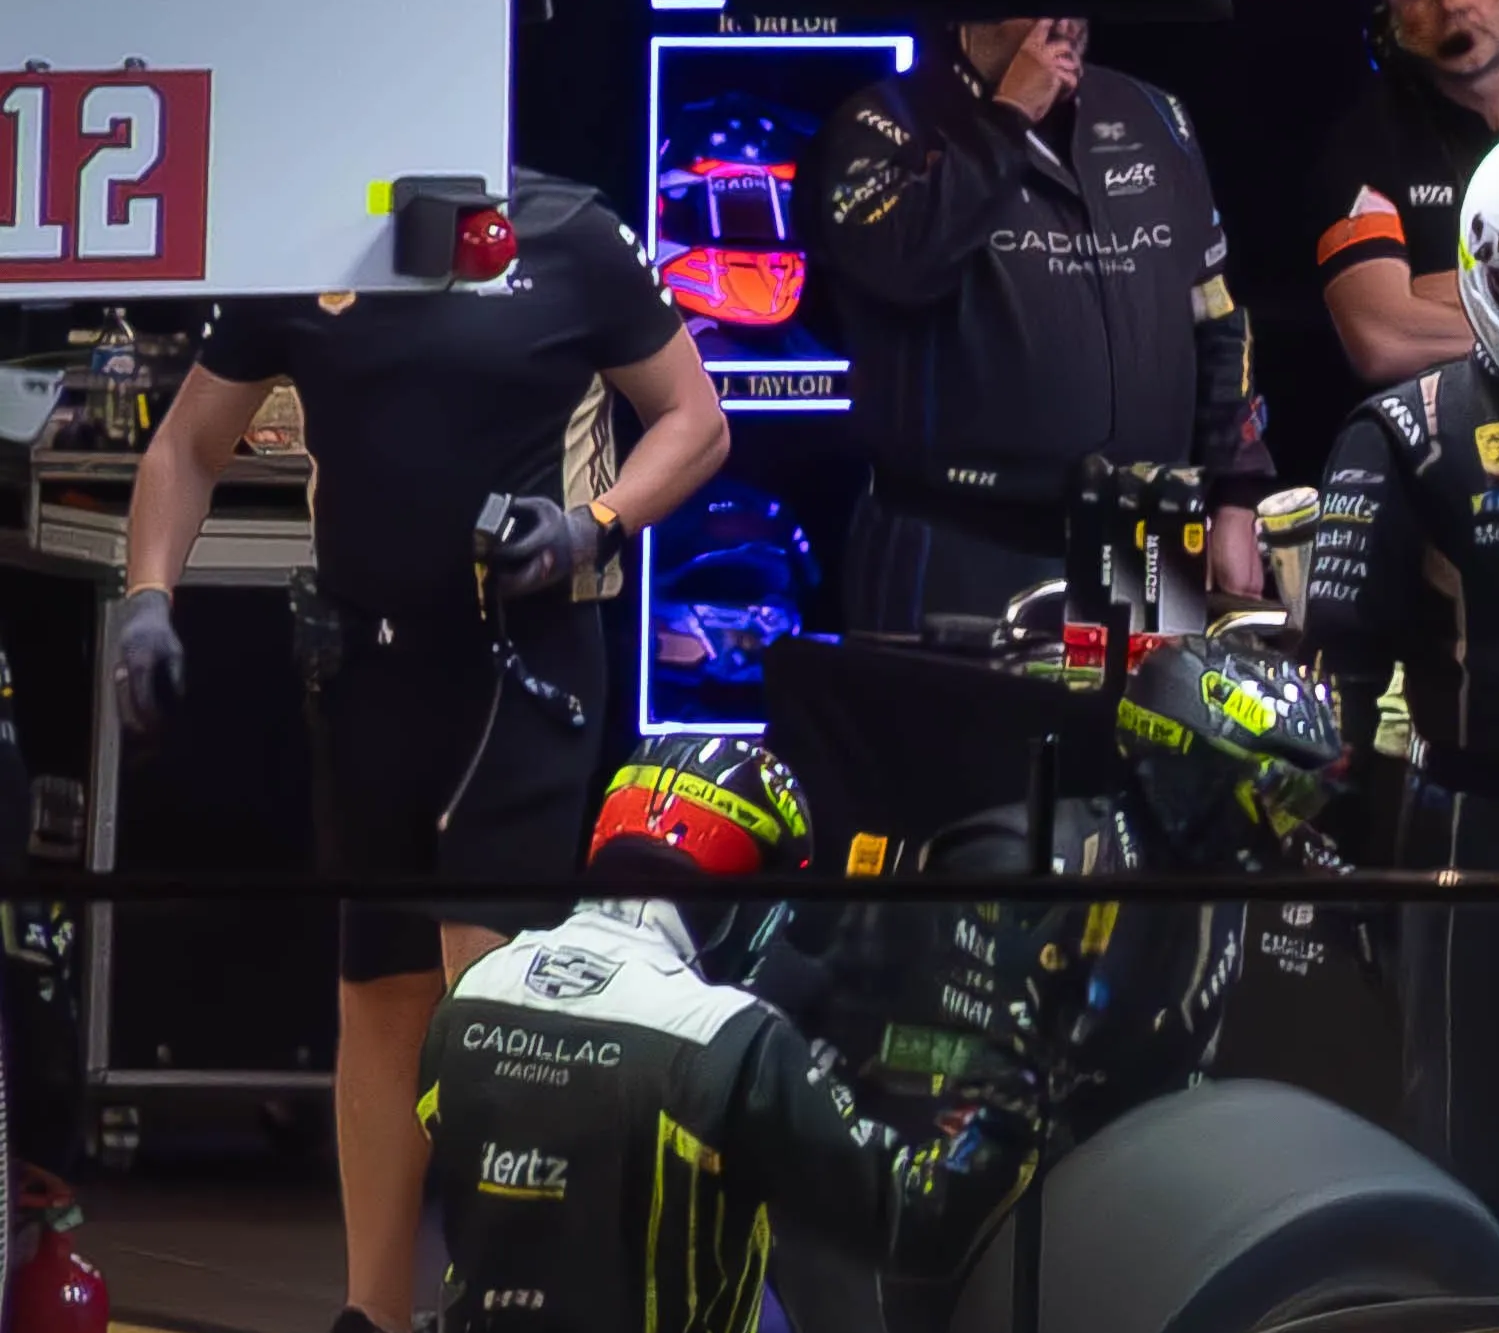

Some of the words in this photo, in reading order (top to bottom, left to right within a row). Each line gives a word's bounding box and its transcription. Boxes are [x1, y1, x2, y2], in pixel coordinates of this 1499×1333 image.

[1, 84, 164, 262] 12
[988, 224, 1174, 256] CADILLAC
[748, 374, 833, 397] TAYLOR
[462, 1021, 622, 1067] CADILLAC
